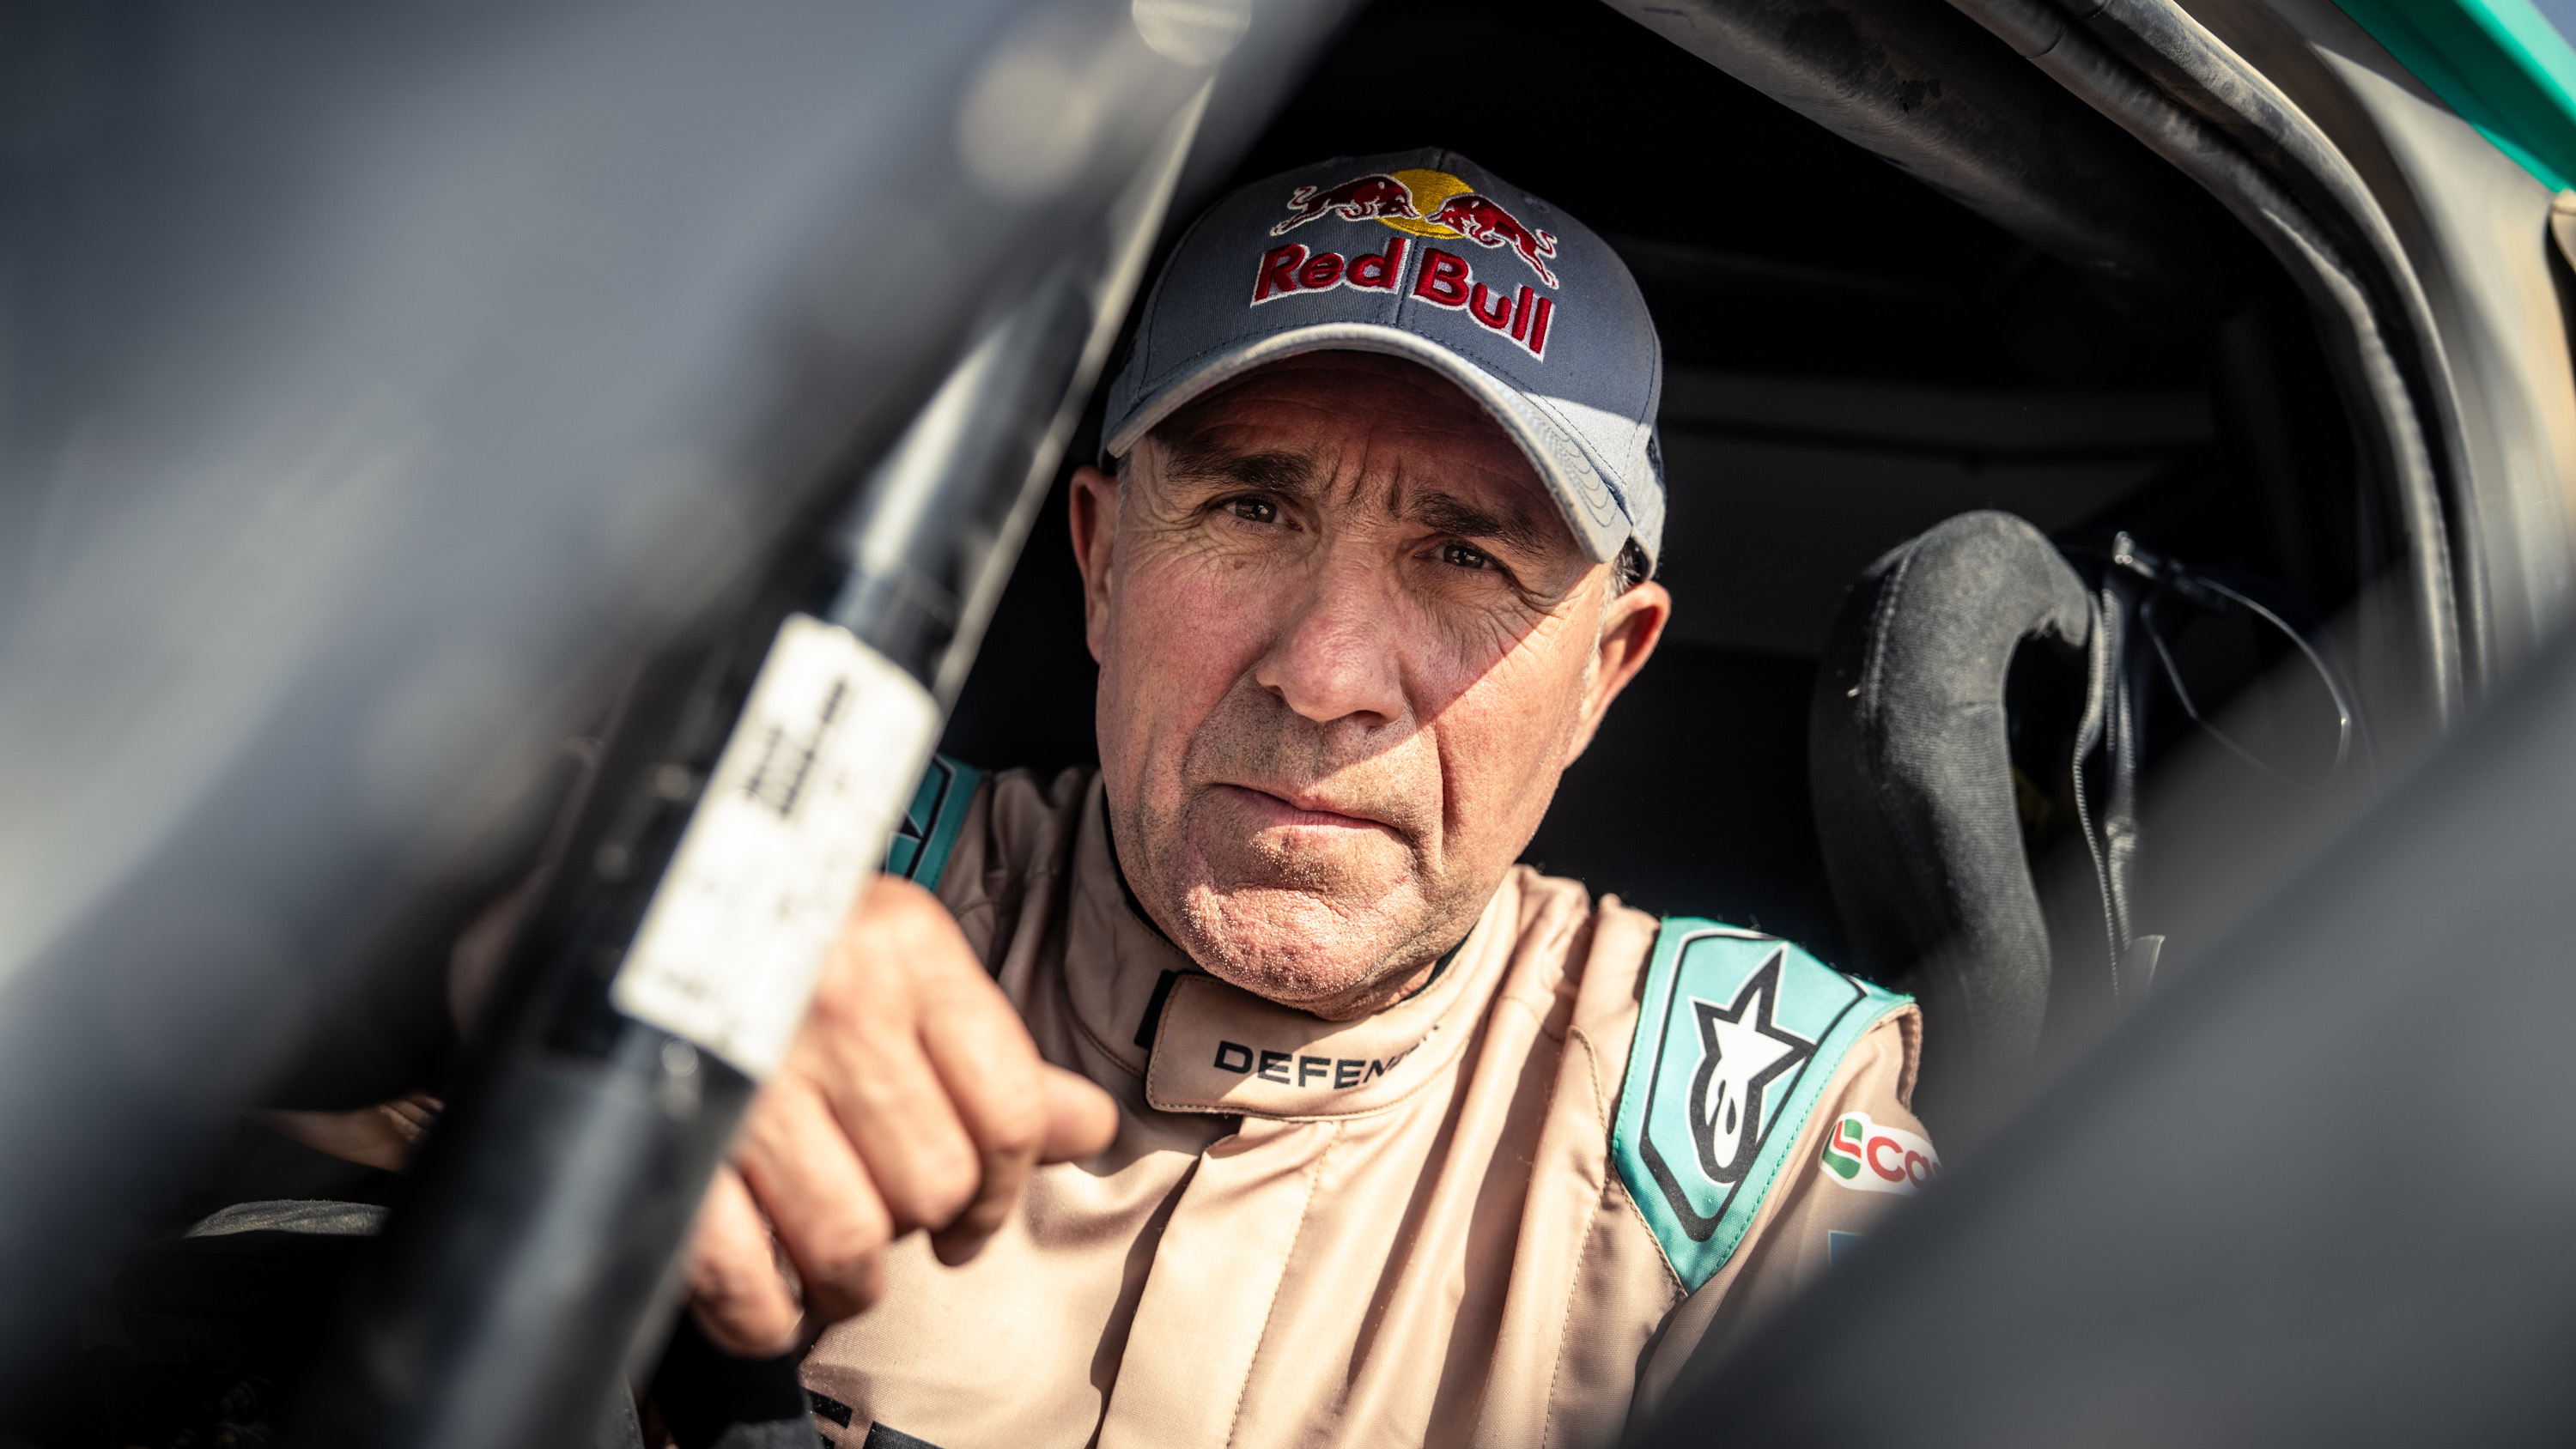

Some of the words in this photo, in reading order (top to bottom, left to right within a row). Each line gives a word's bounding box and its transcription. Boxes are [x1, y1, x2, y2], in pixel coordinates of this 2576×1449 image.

[1251, 237, 1410, 306] Red
[1411, 246, 1554, 361] Bull
[1213, 1025, 1439, 1090] DEFEN
